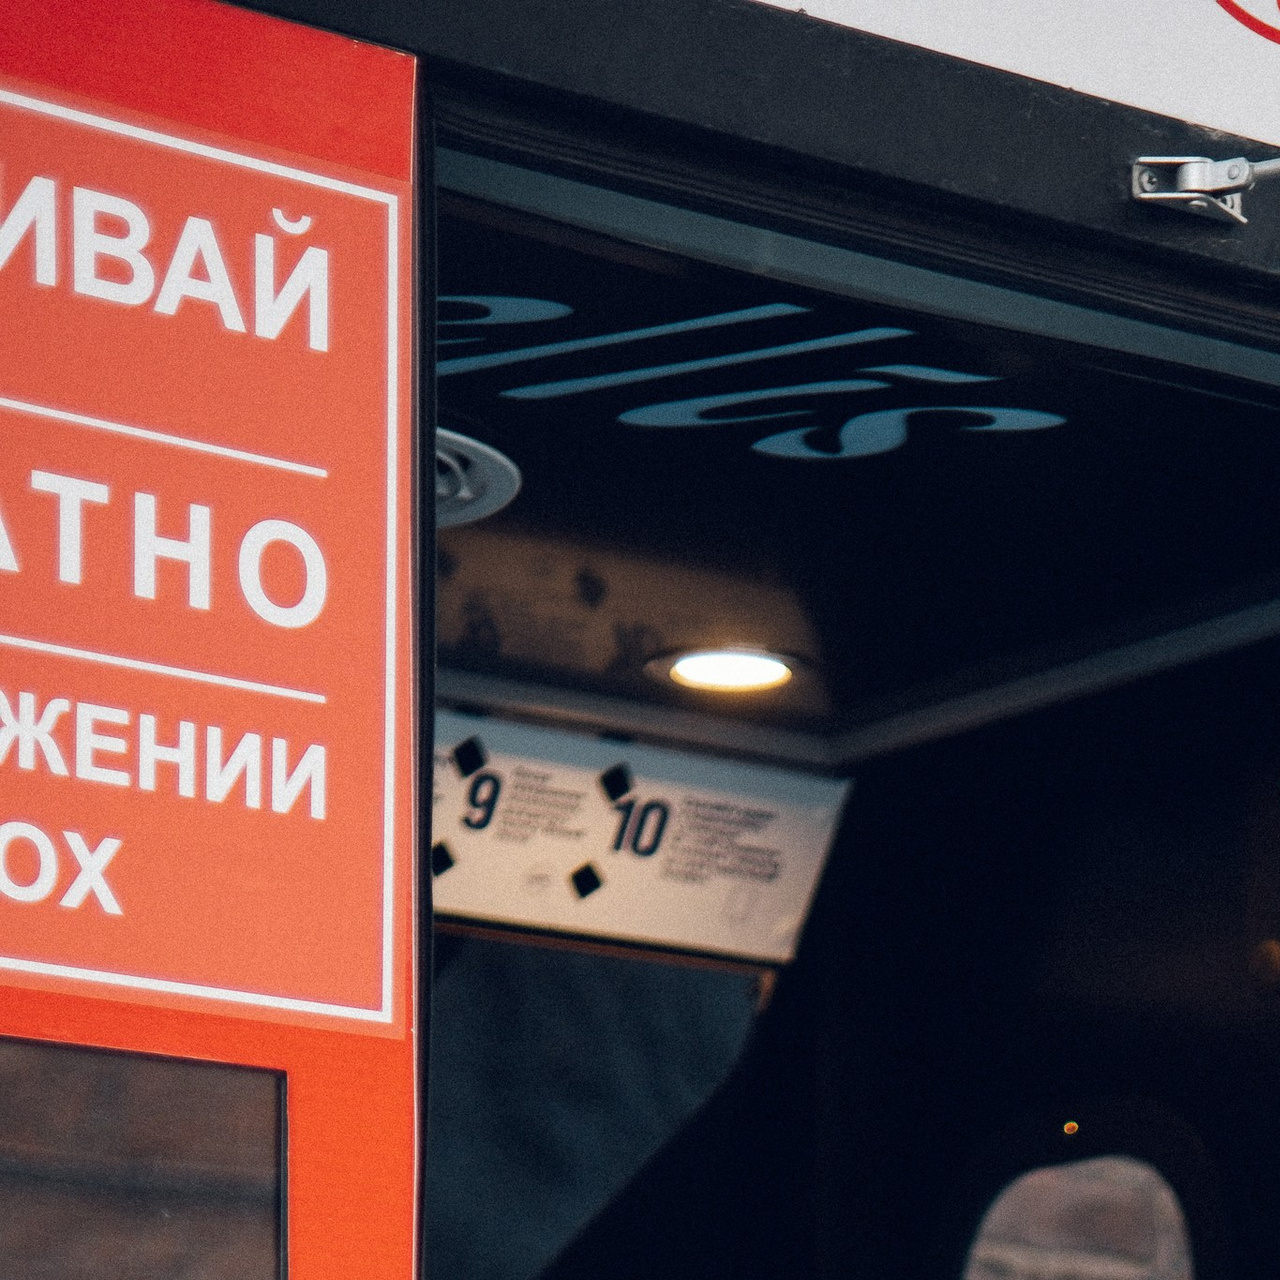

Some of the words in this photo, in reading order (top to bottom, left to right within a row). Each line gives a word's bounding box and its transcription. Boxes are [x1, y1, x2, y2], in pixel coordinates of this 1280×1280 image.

[0, 469, 327, 629] ТНО
[463, 771, 501, 831] 9
[612, 799, 670, 857] 10
